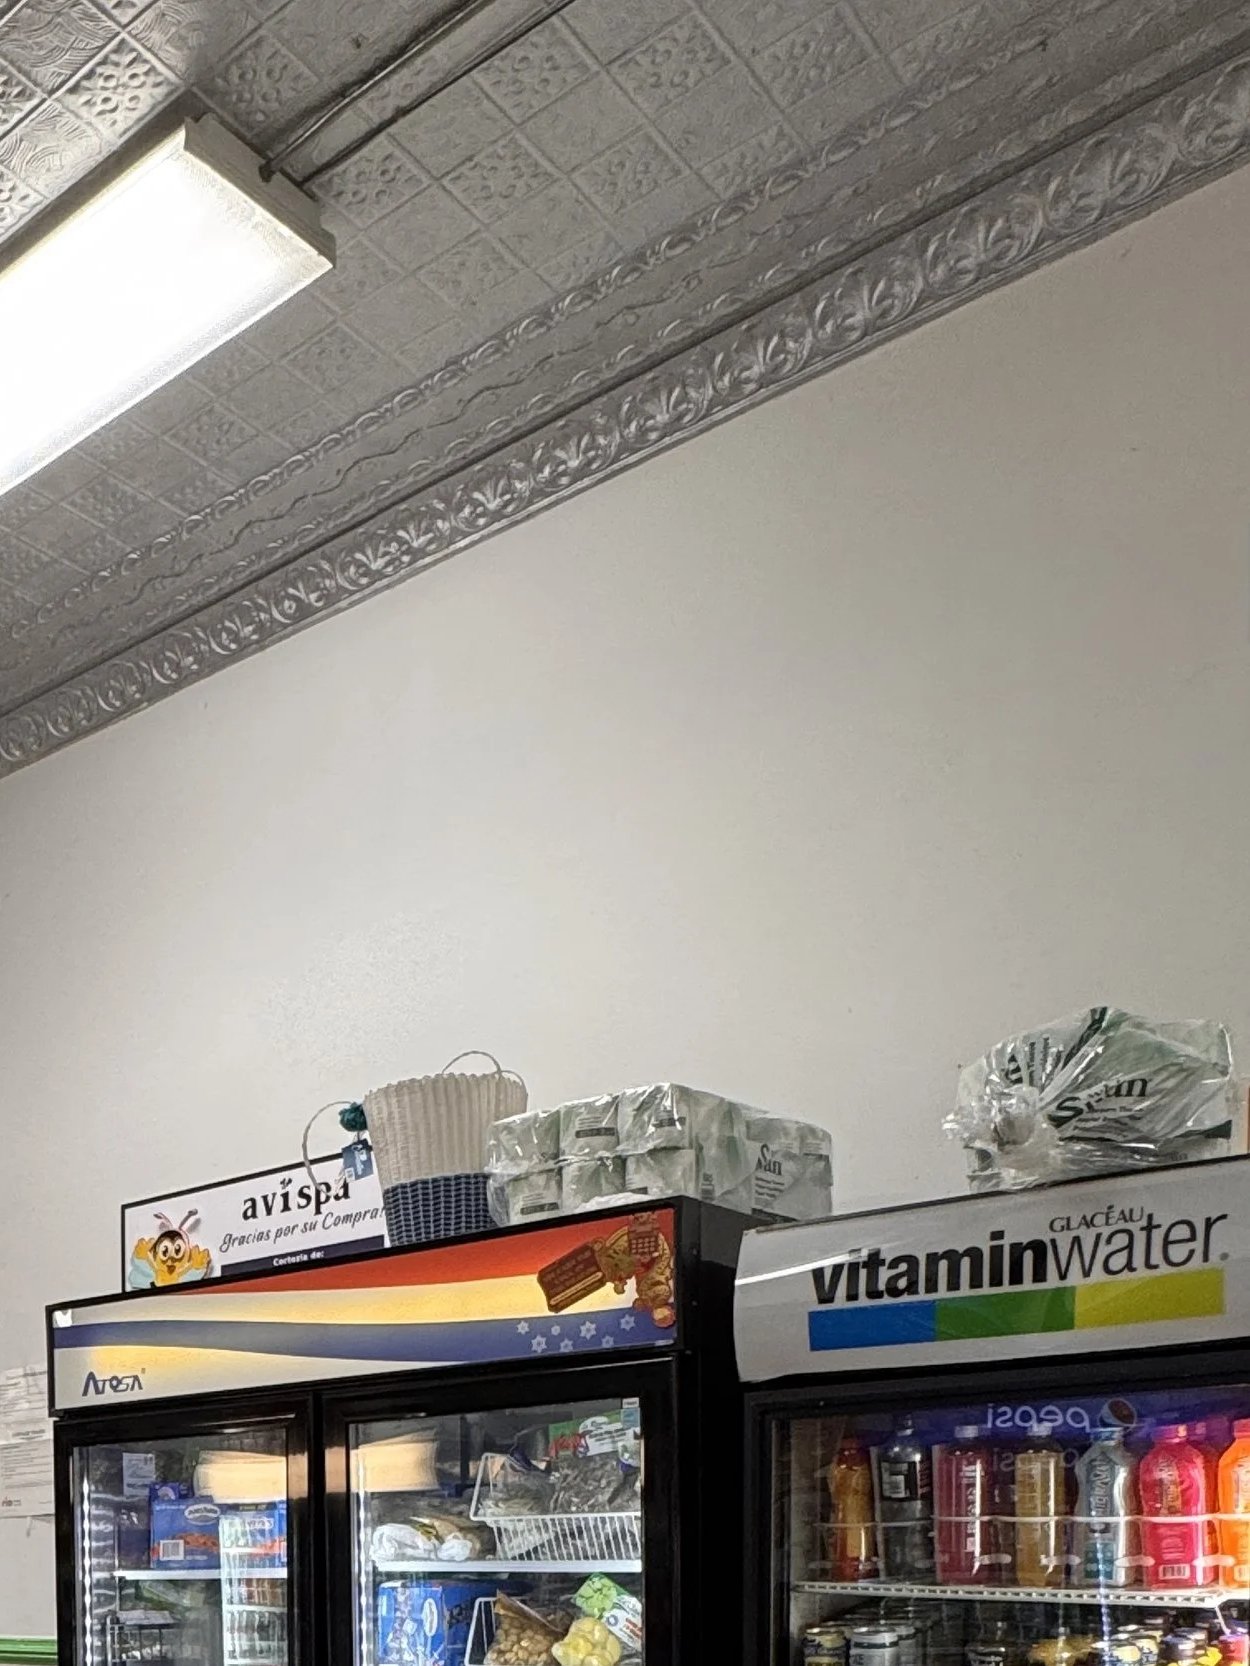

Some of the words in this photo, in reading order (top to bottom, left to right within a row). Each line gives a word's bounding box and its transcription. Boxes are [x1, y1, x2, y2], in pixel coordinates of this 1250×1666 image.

[242, 1177, 350, 1221] avispa
[274, 1224, 299, 1243] por
[301, 1220, 318, 1234] su
[1050, 1205, 1144, 1233] GLACÉAU
[812, 1210, 1229, 1305] vitaminwater
